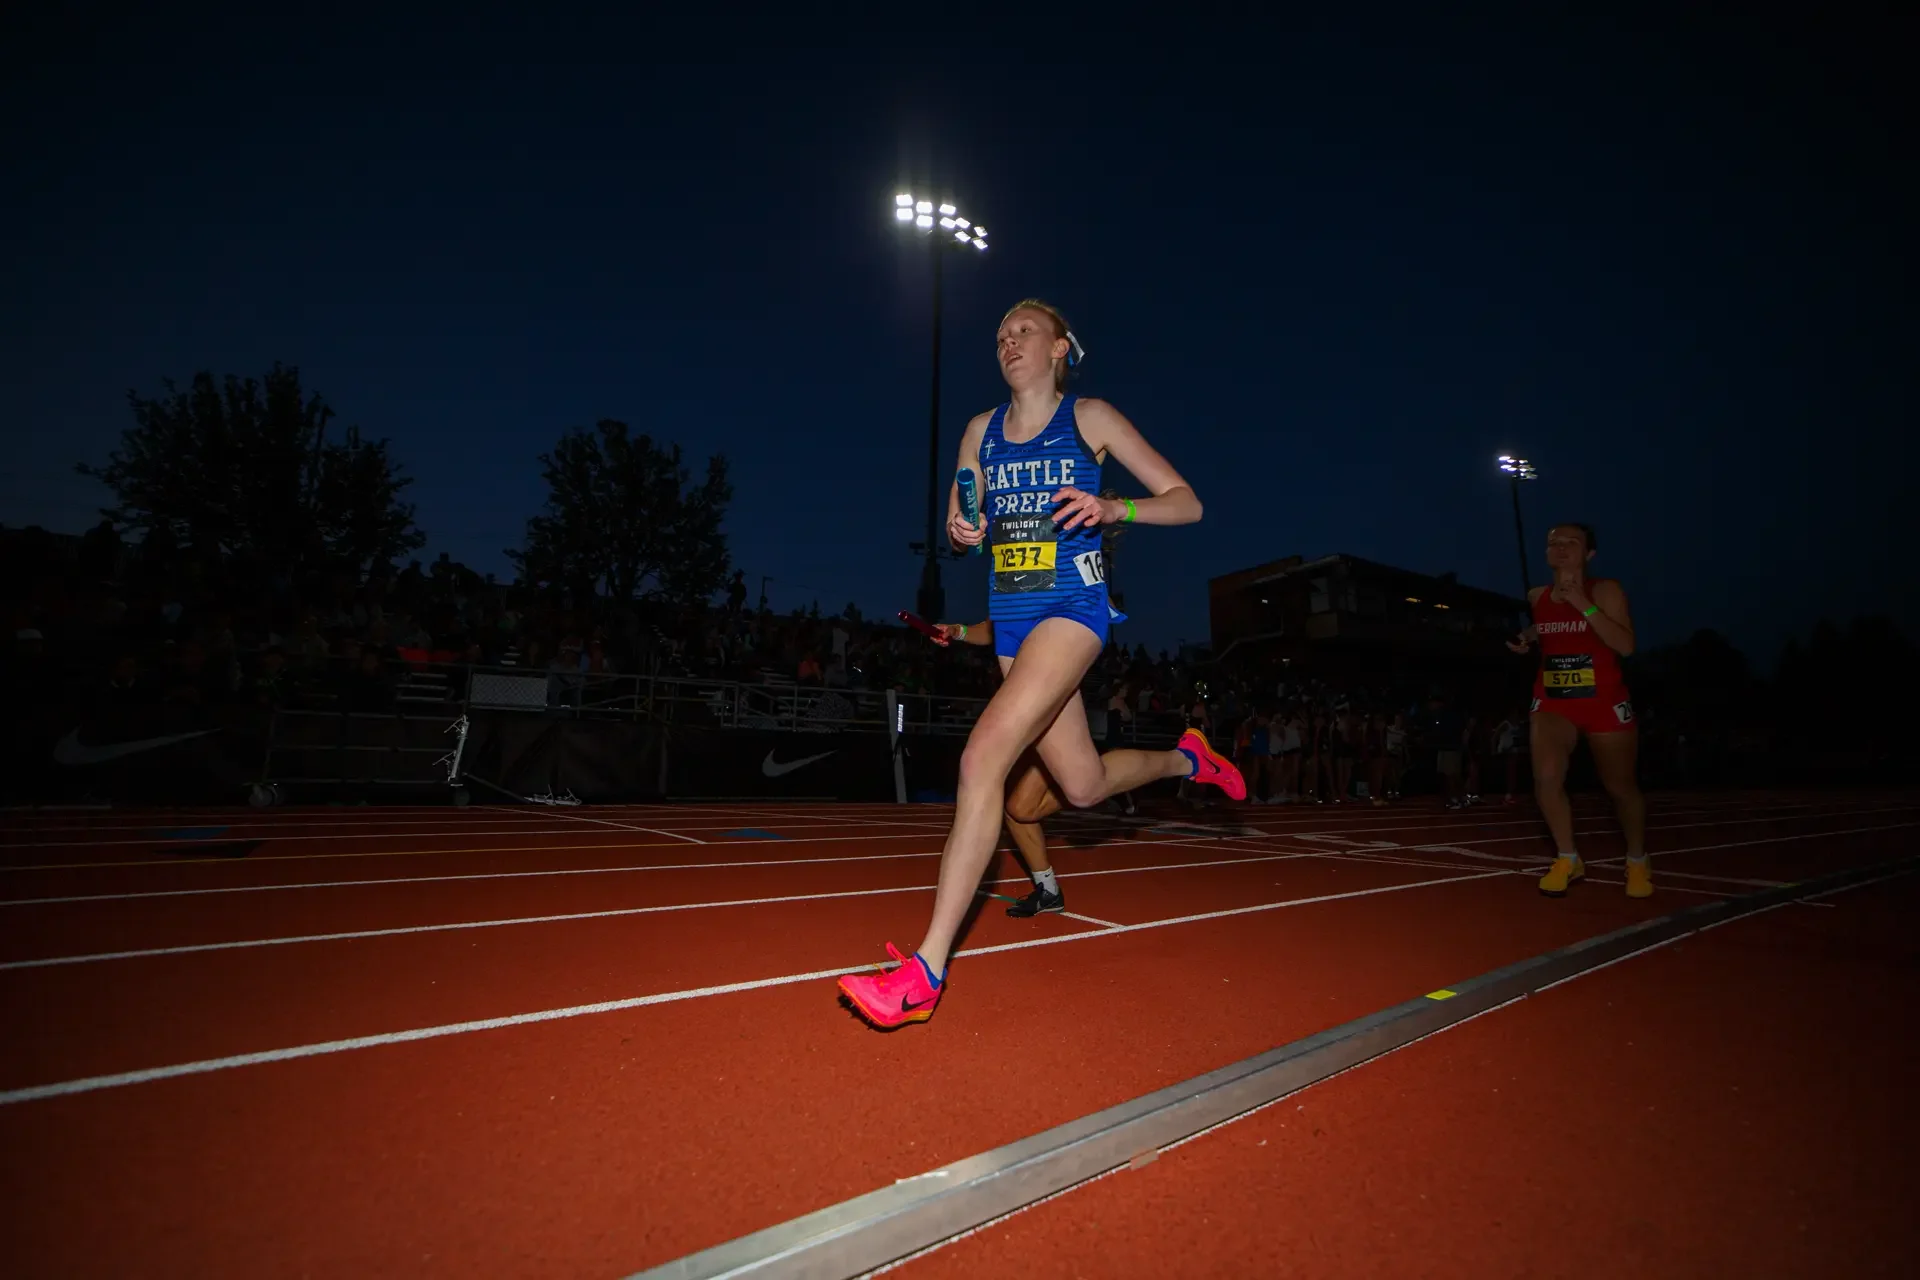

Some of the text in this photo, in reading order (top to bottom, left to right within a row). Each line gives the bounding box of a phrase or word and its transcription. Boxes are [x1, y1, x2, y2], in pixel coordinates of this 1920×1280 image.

[995, 492, 1050, 515] PREP
[1002, 520, 1040, 530] TWILIGHT
[1000, 546, 1042, 568] 1277
[1552, 672, 1582, 685] 570
